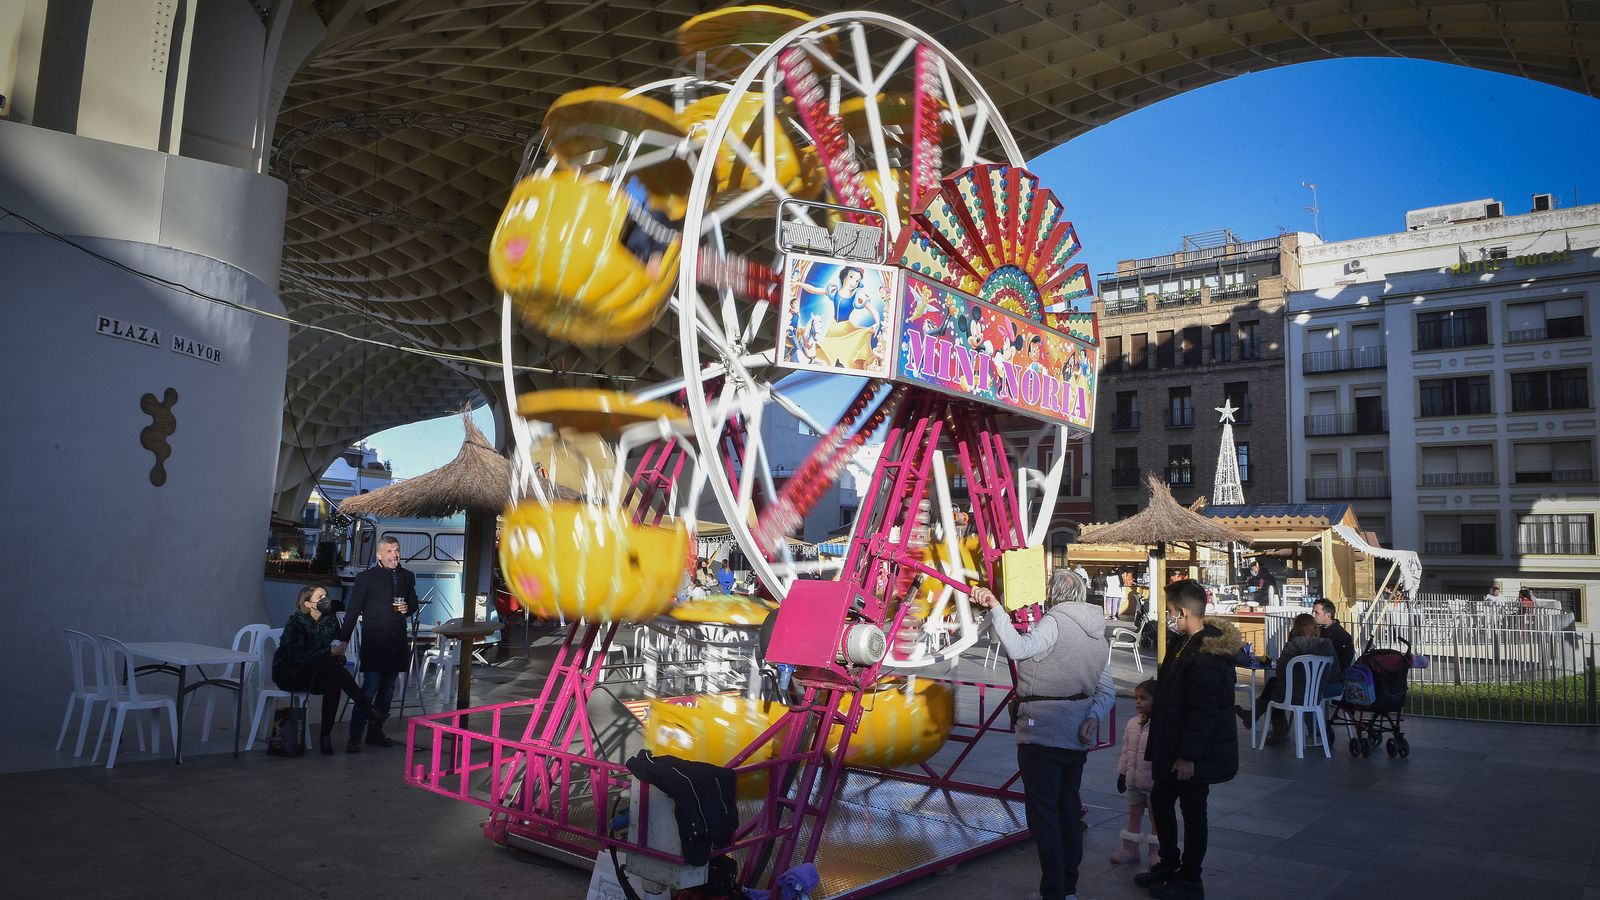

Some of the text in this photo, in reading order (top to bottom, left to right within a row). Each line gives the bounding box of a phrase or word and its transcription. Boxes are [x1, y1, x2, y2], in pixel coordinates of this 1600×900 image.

[98, 317, 221, 362] PLAZA MAYOR
[905, 328, 1088, 419] MINI NORIA
